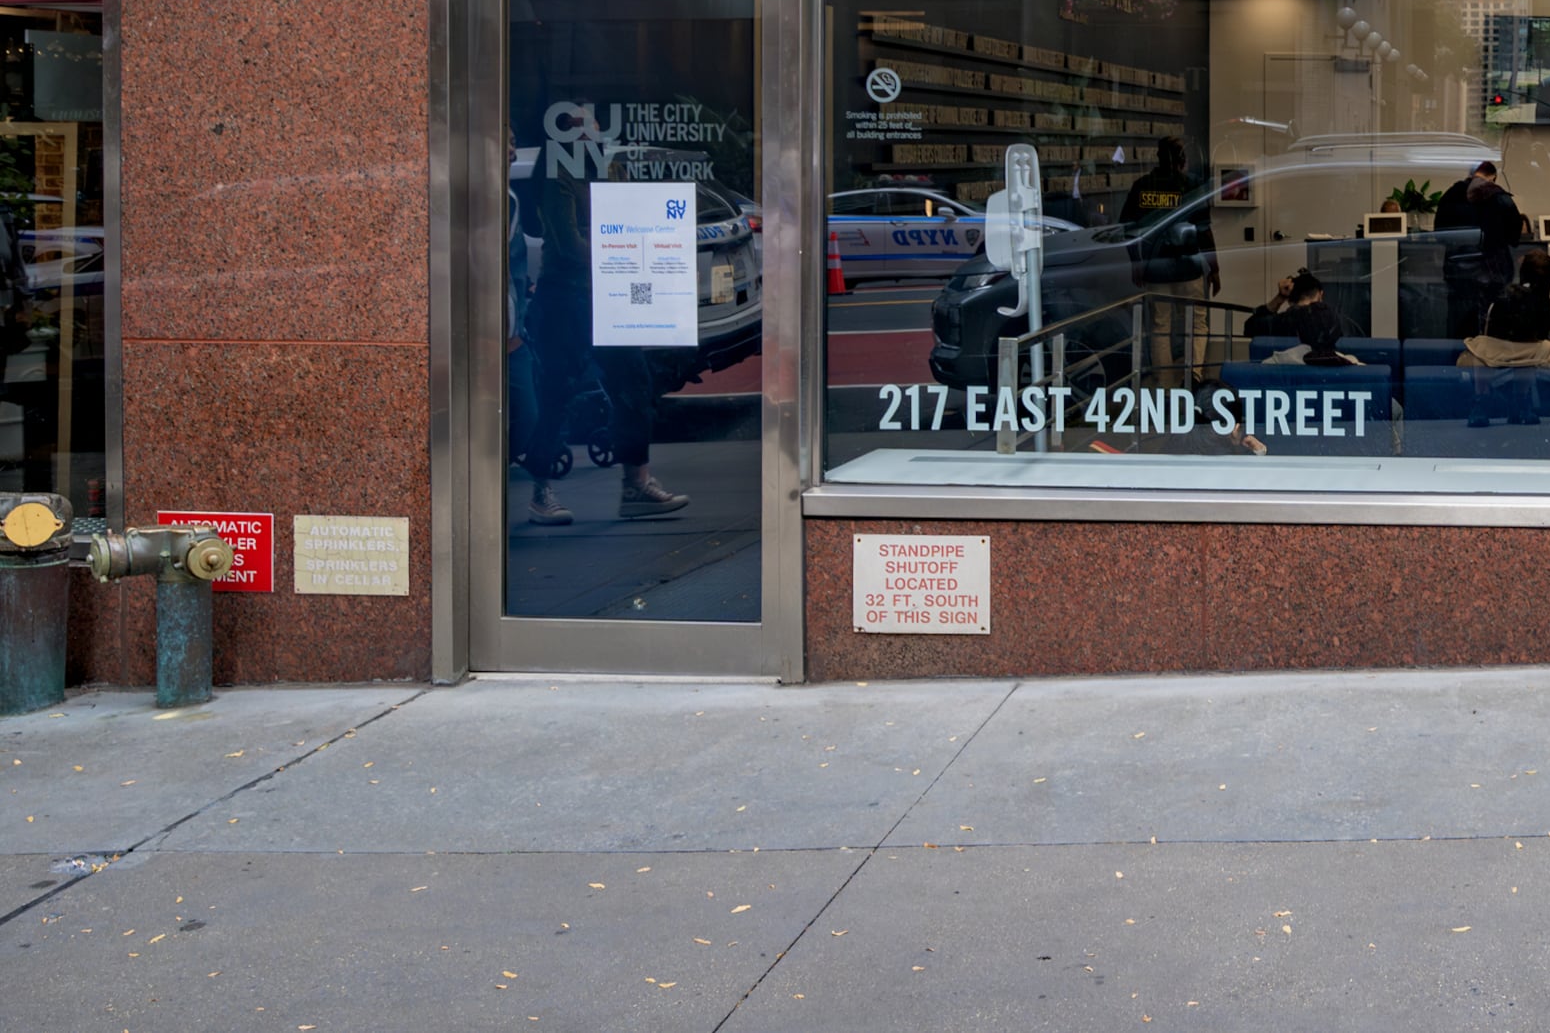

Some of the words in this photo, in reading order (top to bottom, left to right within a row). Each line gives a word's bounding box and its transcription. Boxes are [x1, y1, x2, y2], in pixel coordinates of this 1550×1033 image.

[626, 103, 660, 122] THE
[664, 103, 702, 123] CITY
[846, 111, 877, 120] Smoking
[886, 111, 922, 120] prohibited
[855, 121, 877, 129] within
[878, 121, 888, 129] 25
[889, 121, 904, 129] feet
[626, 123, 726, 142] UNIVERSITY
[846, 130, 855, 139] all
[856, 130, 885, 140] building
[886, 131, 922, 139] entrances
[626, 142, 649, 160] OF
[626, 161, 666, 180] NEW
[669, 161, 715, 180] YORK
[1142, 193, 1180, 207] SECURITY
[600, 224, 624, 235] CUNY
[879, 384, 949, 431] 217
[966, 385, 1071, 432] EAST
[1084, 387, 1195, 434] 42ND
[1211, 389, 1372, 437] STREET
[310, 526, 394, 537] AUTOMATIC
[879, 544, 965, 557] STANDPIPE
[306, 559, 398, 572] SPRINKLERS
[885, 561, 959, 574] SHUTOFF
[312, 574, 327, 584] IN
[335, 574, 391, 585] CELLAR
[885, 577, 958, 591] LOCATED
[865, 594, 885, 607] 32
[892, 594, 916, 607] FT.
[924, 594, 979, 607] SOUTH
[866, 610, 888, 624] OF
[895, 610, 931, 624] THIS
[939, 611, 978, 624] SIGN
